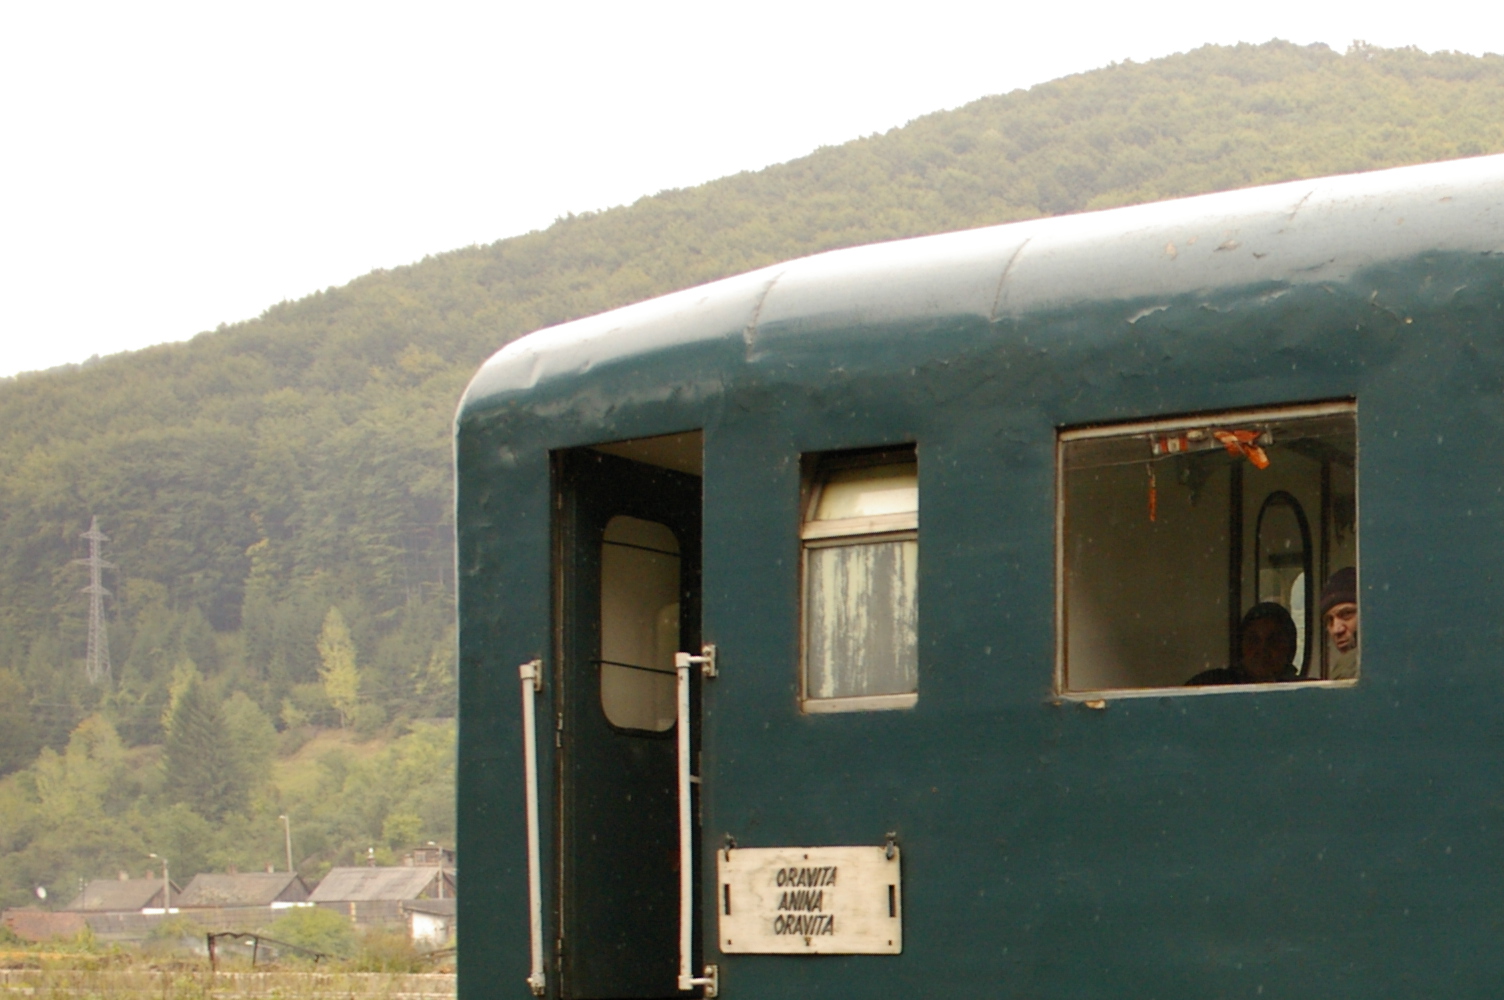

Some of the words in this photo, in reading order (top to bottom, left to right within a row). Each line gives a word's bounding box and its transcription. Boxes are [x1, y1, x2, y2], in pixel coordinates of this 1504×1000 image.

[776, 867, 838, 887] ORAVITA
[778, 890, 823, 911] ANINA
[774, 914, 834, 935] ORAVITA
